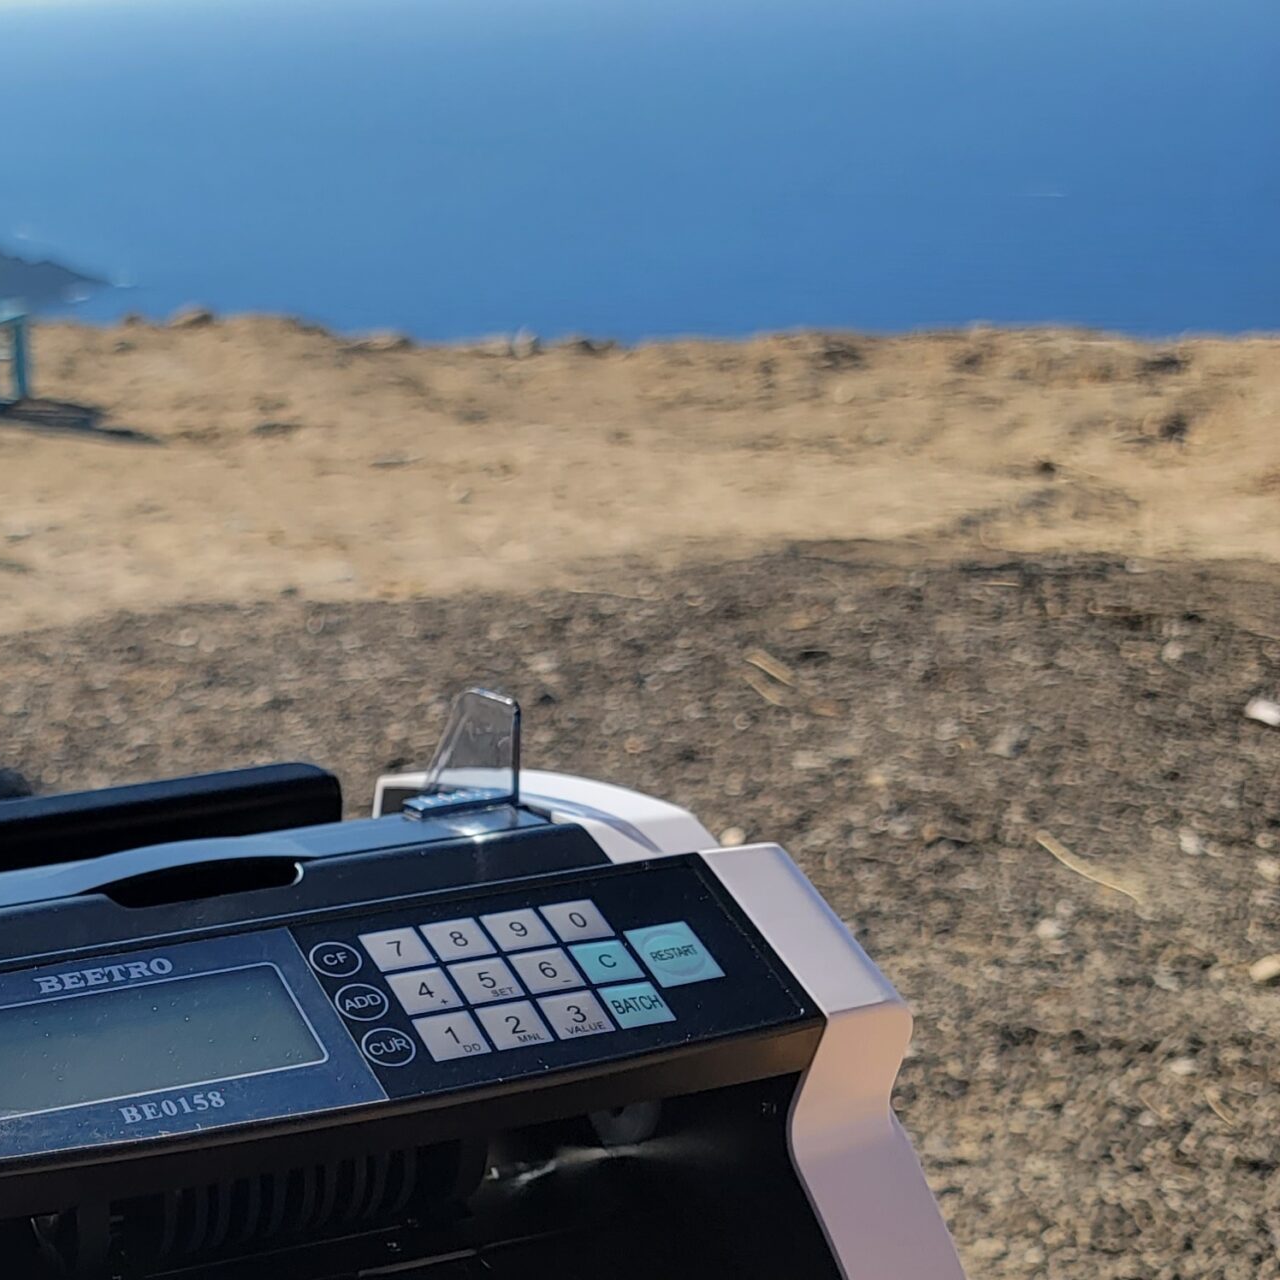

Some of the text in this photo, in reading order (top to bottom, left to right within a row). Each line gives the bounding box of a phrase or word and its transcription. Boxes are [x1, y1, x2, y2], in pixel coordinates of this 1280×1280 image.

[569, 912, 587, 928] 0
[508, 921, 528, 937] 9
[449, 931, 468, 947] 8
[386, 940, 402, 957] 7
[649, 944, 698, 962] RESTART
[323, 951, 348, 966] CF
[598, 953, 617, 968] C
[32, 957, 173, 994] BEETRO
[538, 961, 557, 978] 6
[477, 971, 496, 989] 5
[418, 981, 435, 998] 4
[491, 986, 514, 998] SET
[345, 993, 382, 1011] ADD
[611, 994, 664, 1015] BATCH
[566, 1005, 587, 1023] 3
[505, 1015, 526, 1034] 2
[565, 1021, 607, 1035] VALUE
[444, 1026, 460, 1044] 1
[369, 1037, 411, 1056] CUR
[463, 1042, 481, 1053] DD
[118, 1090, 226, 1124] BE0158
